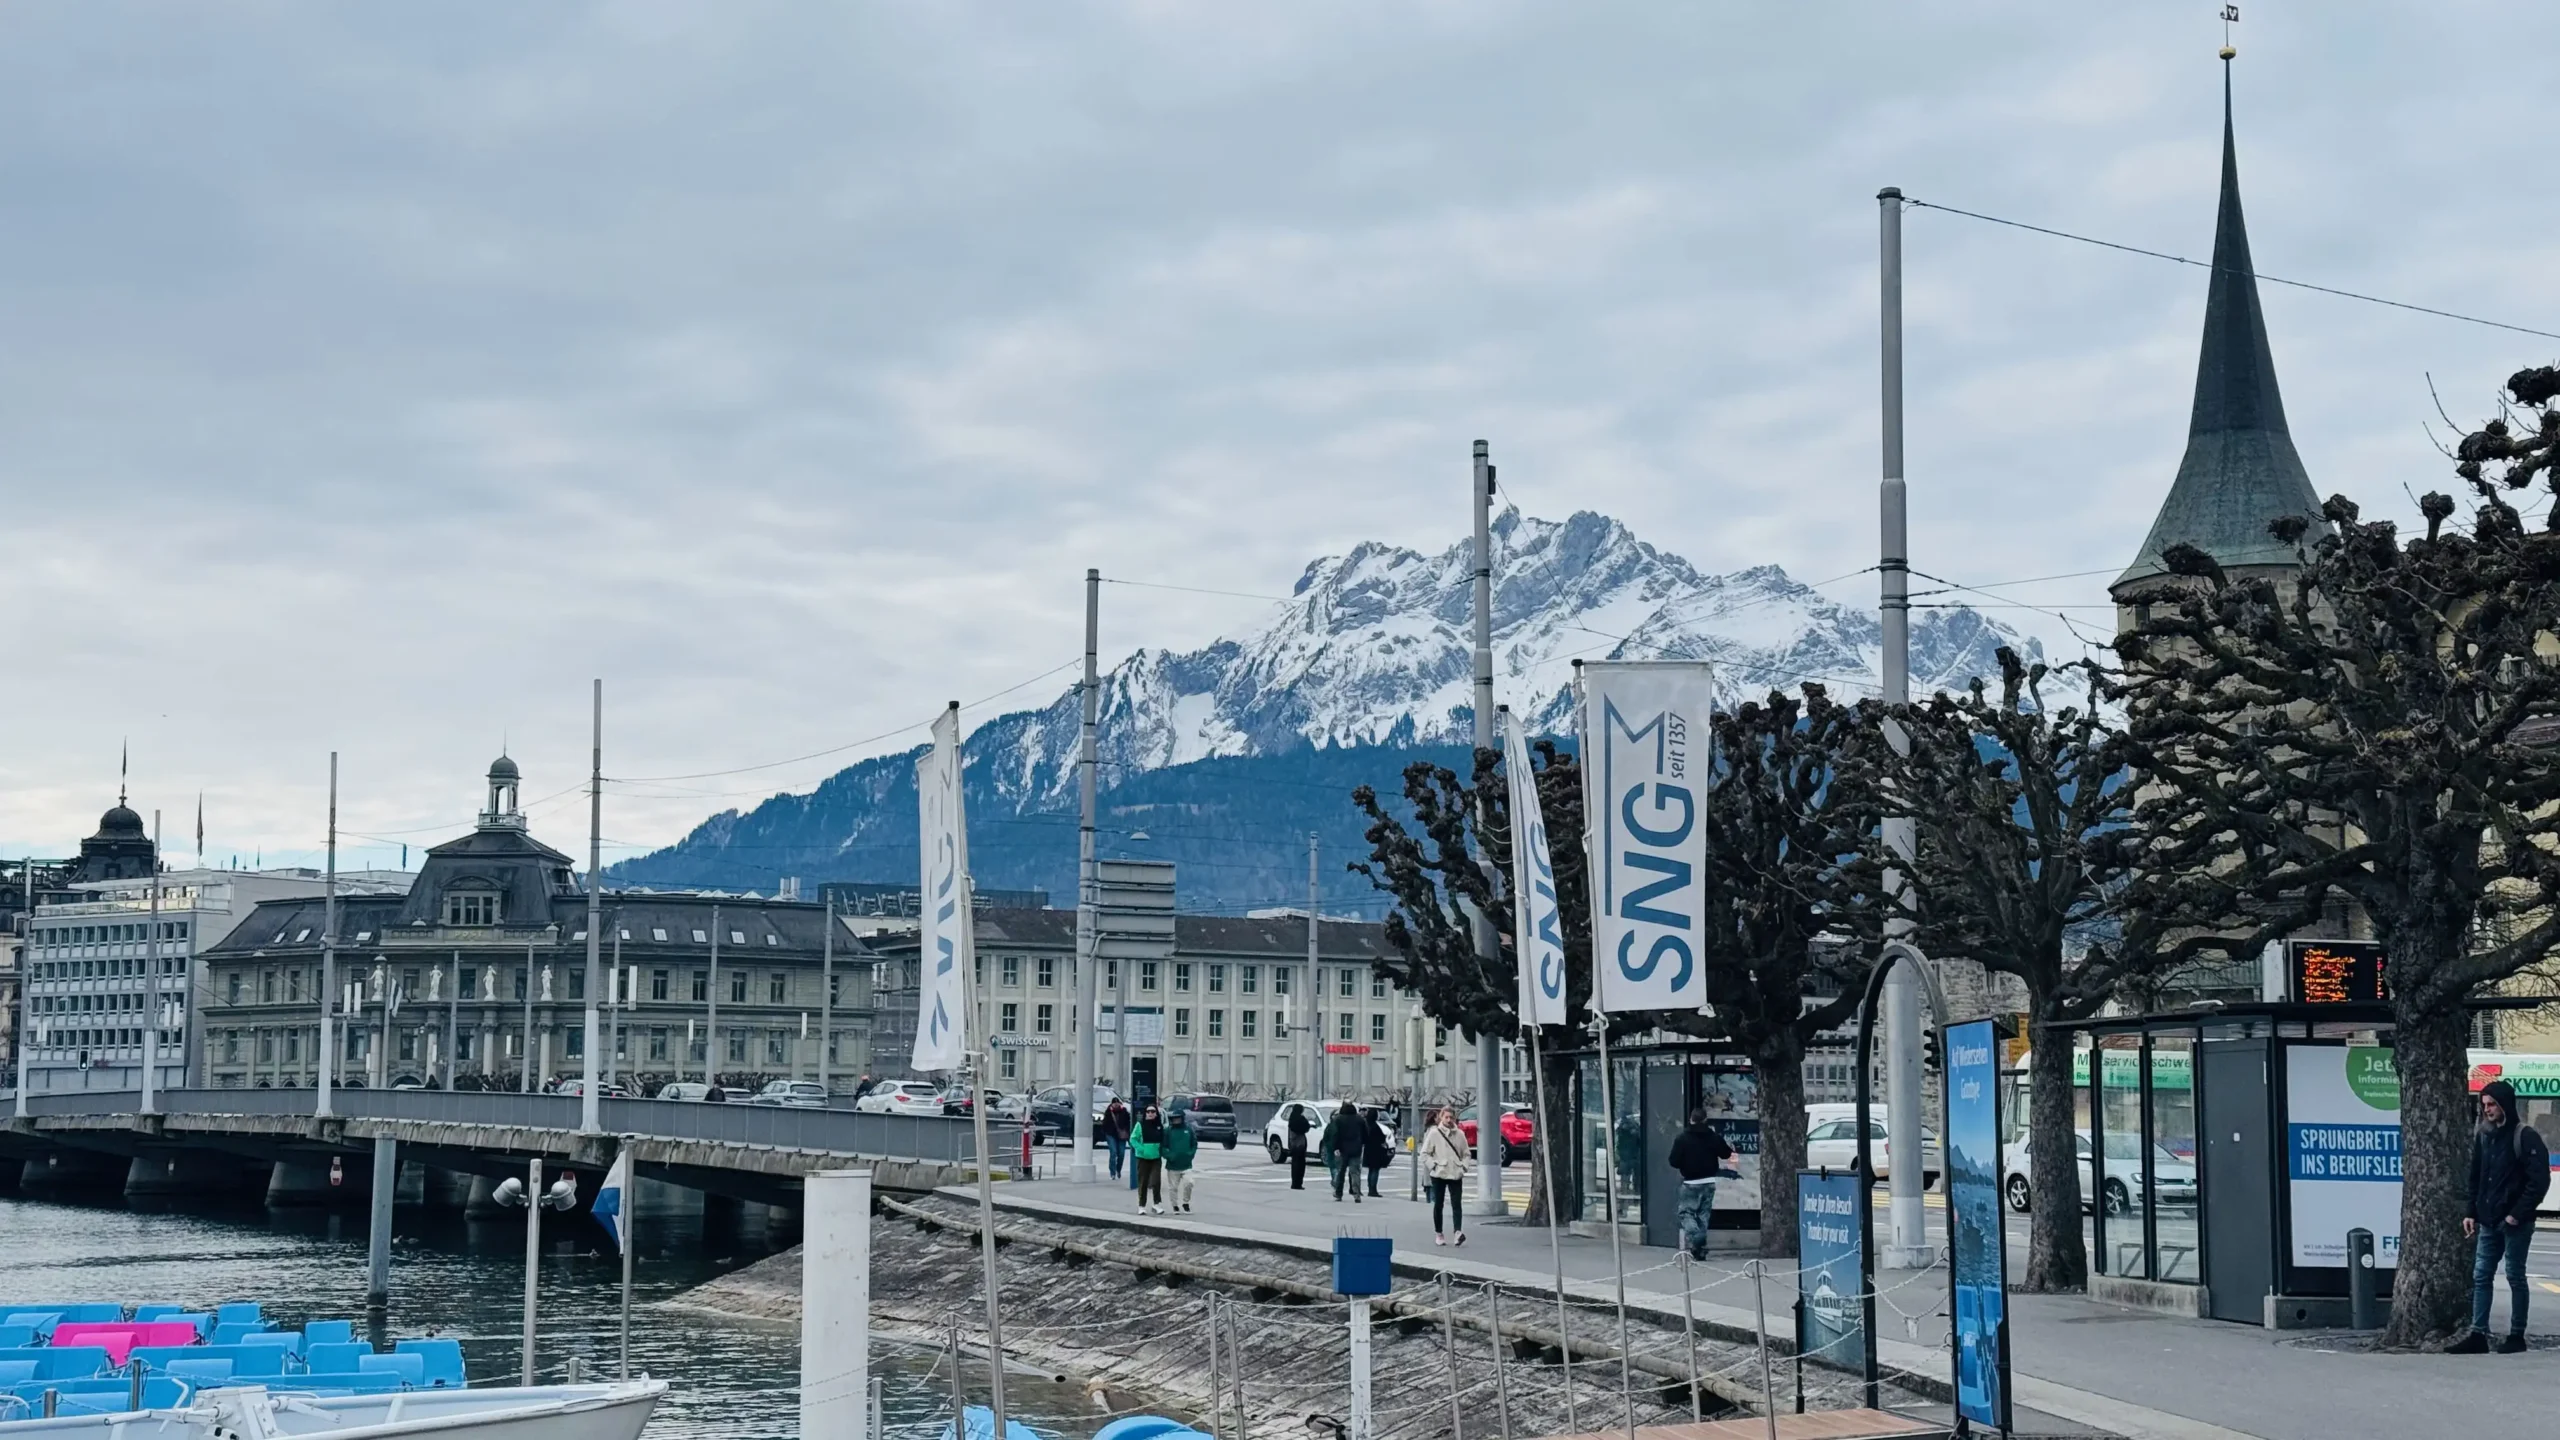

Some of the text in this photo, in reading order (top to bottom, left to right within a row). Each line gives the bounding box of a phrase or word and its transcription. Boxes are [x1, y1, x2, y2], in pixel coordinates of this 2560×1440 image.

[1668, 713, 1687, 780] seit 1357
[1617, 780, 1695, 993] SNG
[1001, 1034, 1050, 1046] swisscom
[2364, 1056, 2396, 1072] Jet
[2519, 1060, 2545, 1070] Sicher
[2300, 1129, 2400, 1151] SPRUNGBRETT
[2301, 1154, 2325, 1175] INS
